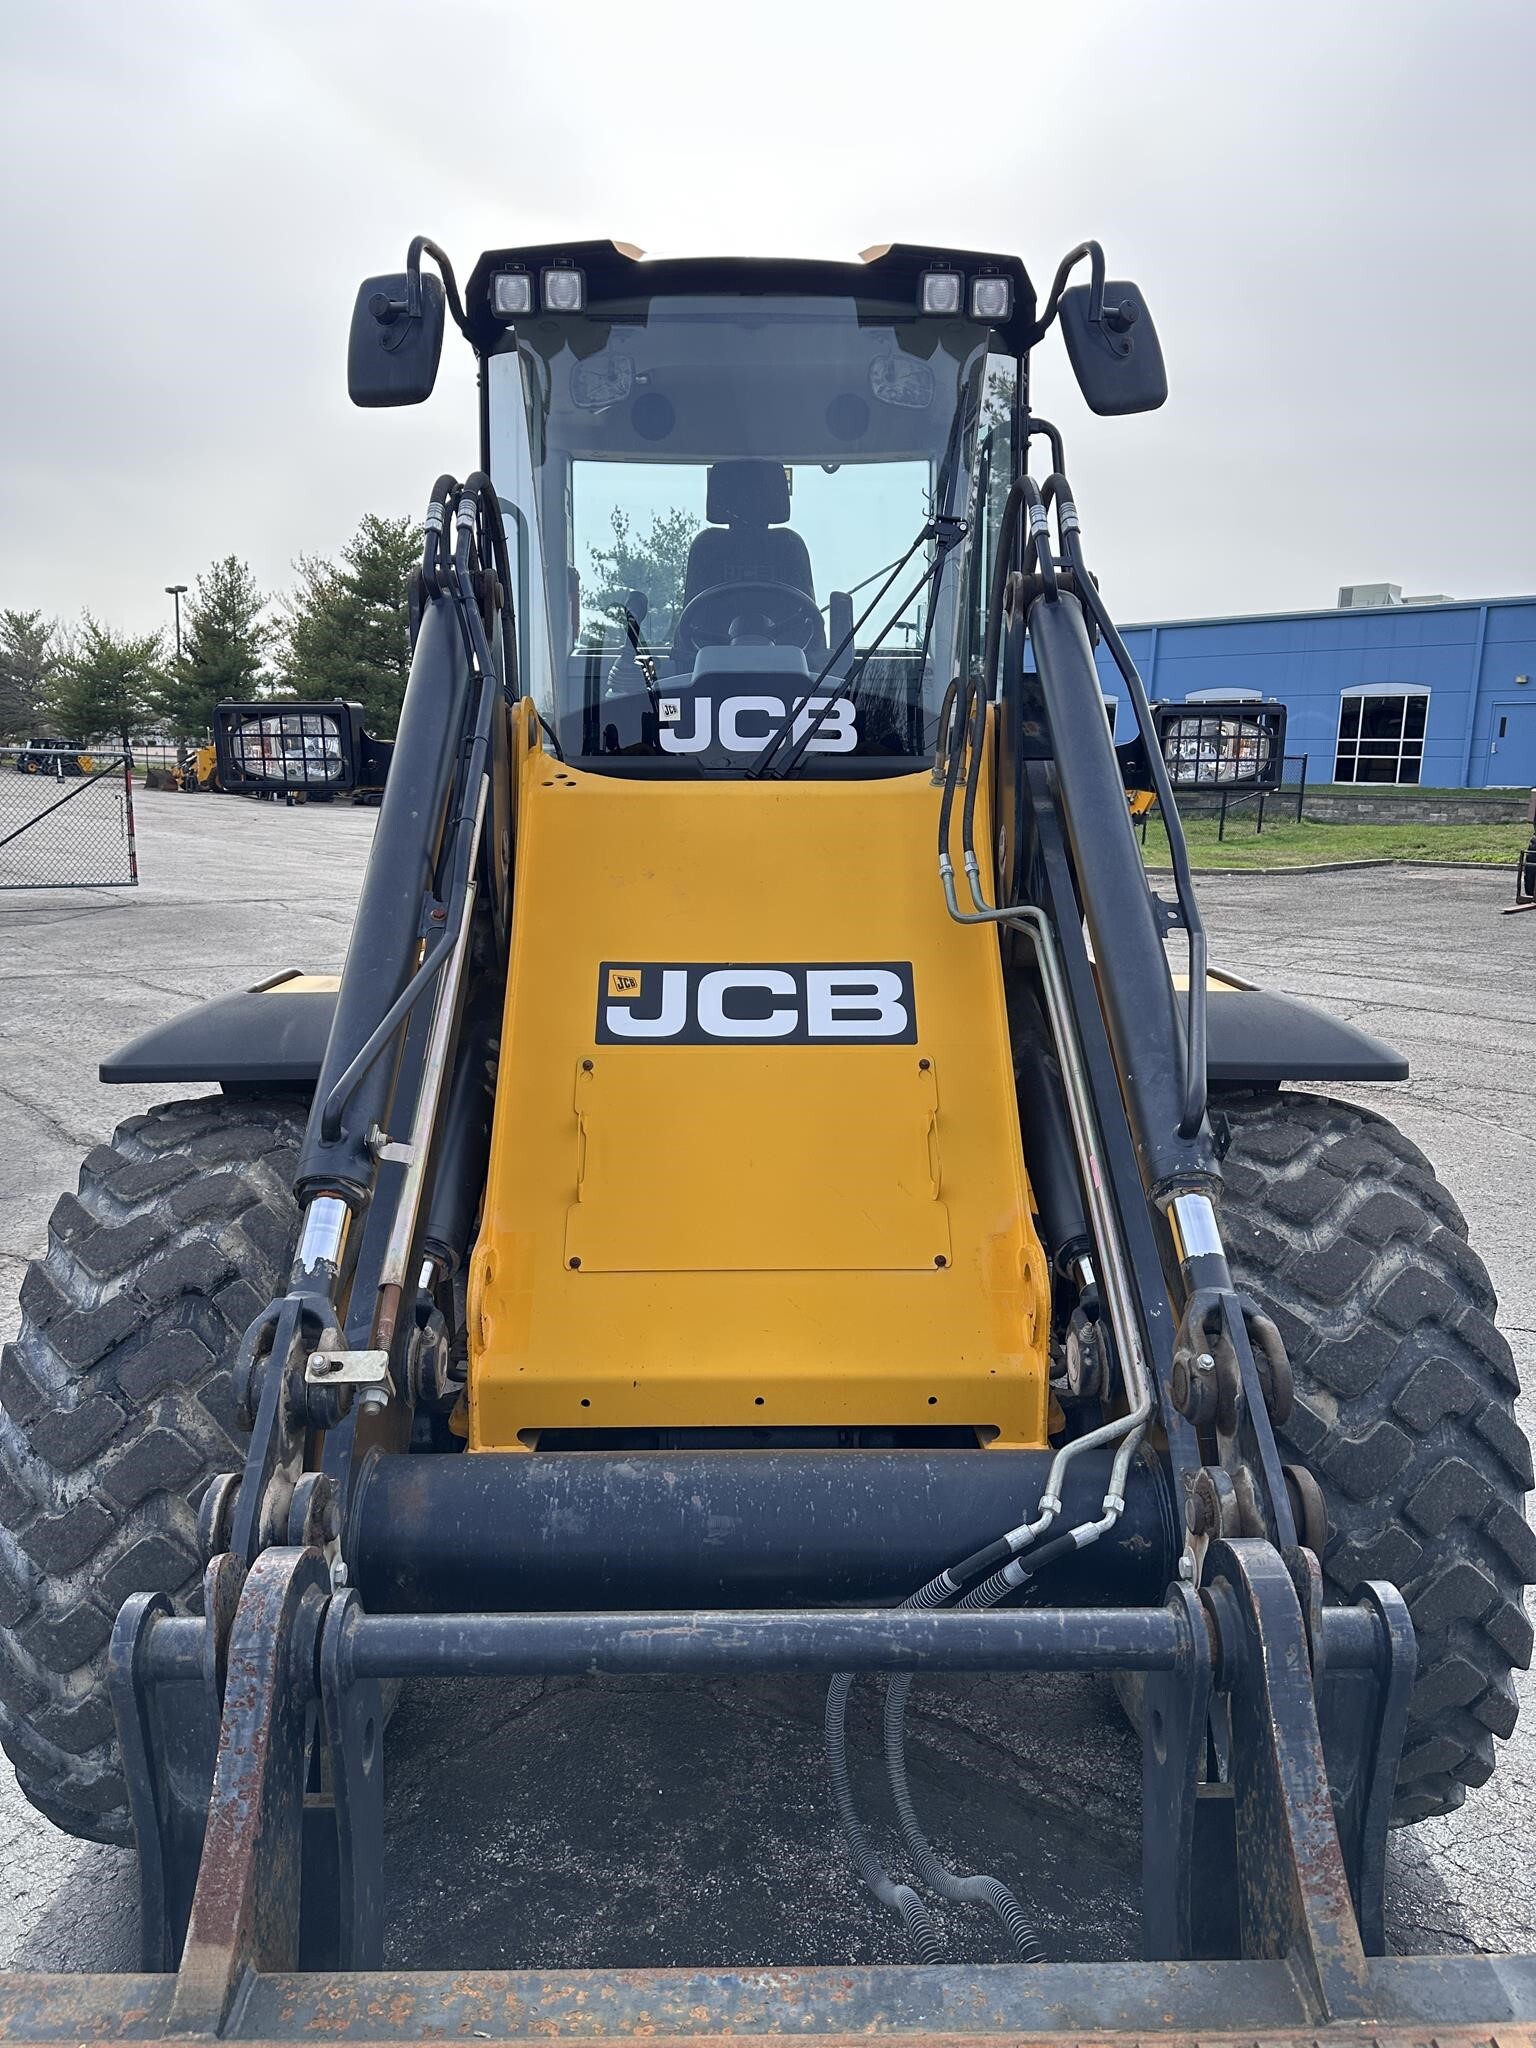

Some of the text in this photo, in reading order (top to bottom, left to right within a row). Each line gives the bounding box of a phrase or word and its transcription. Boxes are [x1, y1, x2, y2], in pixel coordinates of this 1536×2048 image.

[659, 696, 858, 753] JCB
[607, 969, 908, 1037] JCB
[617, 976, 636, 990] JCB
